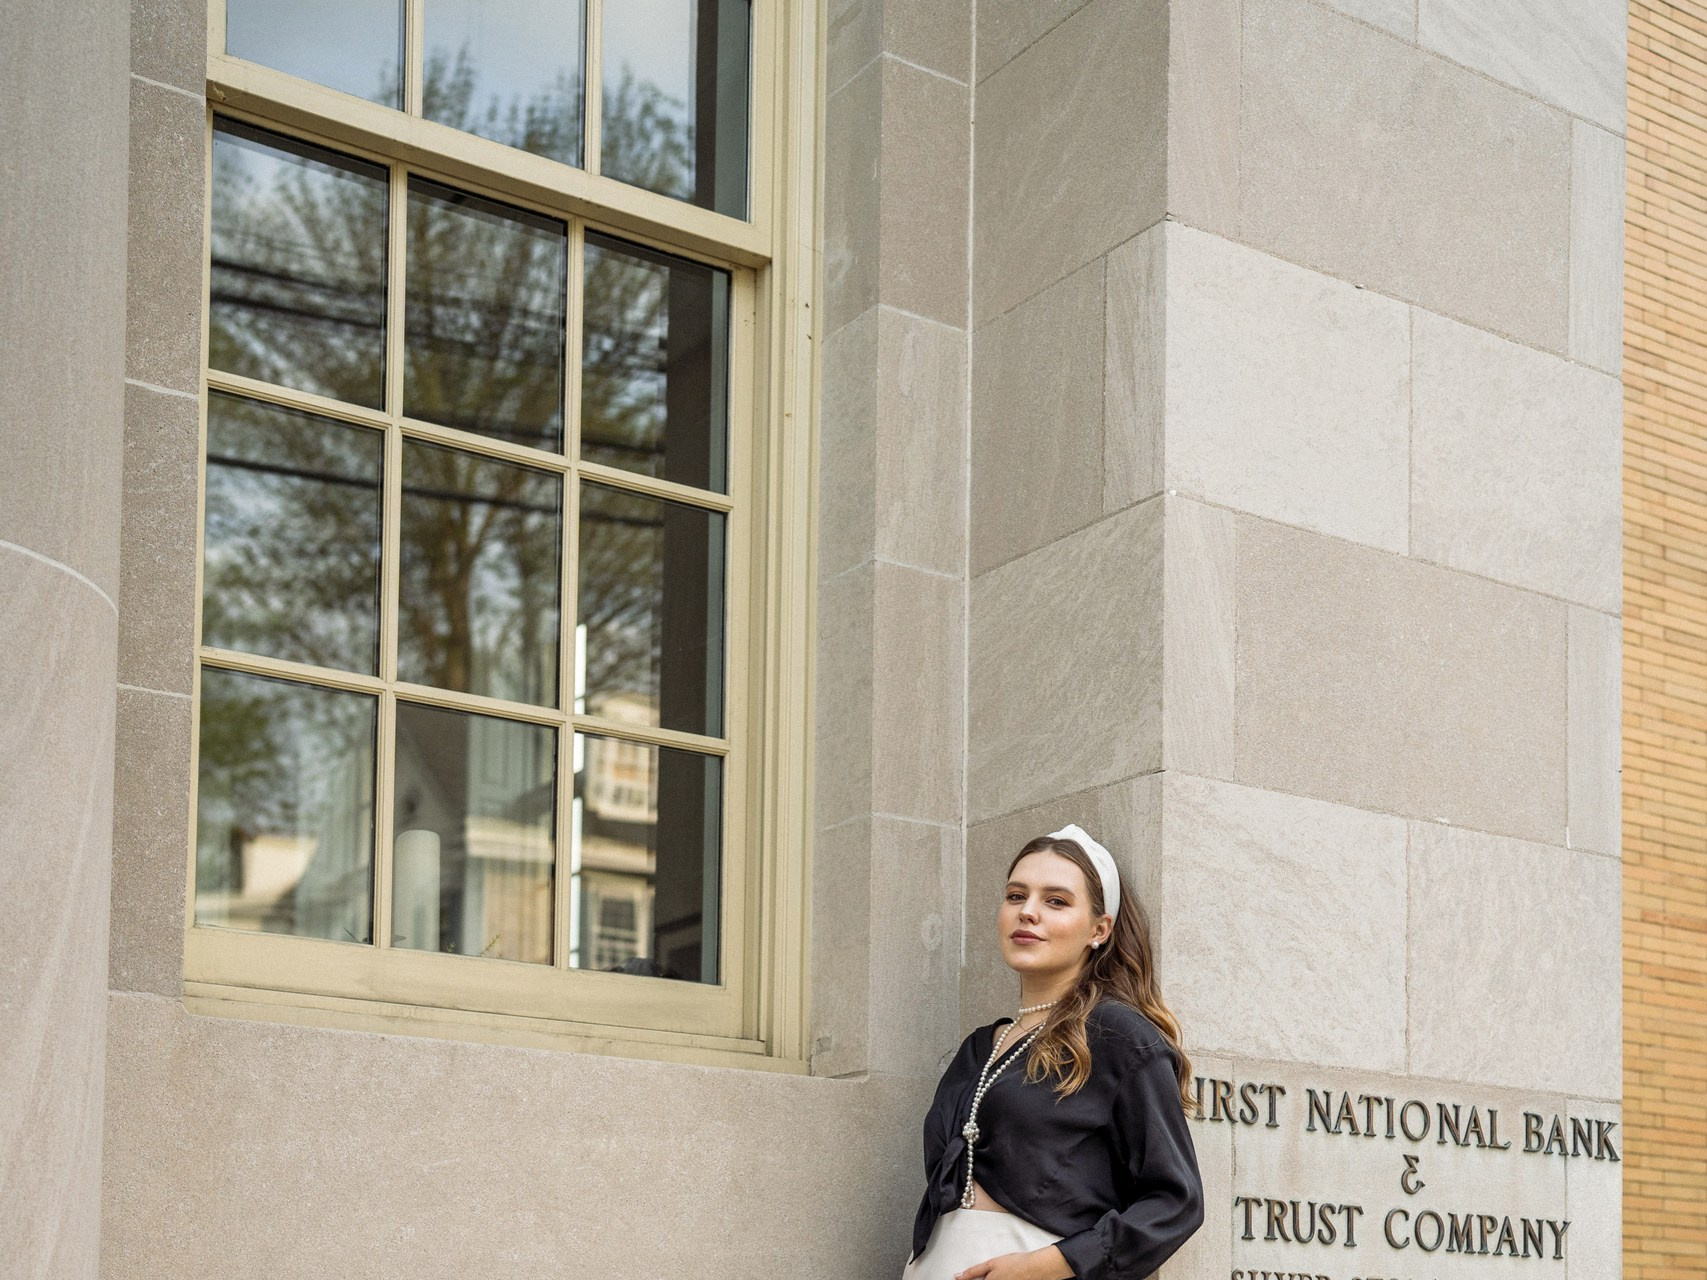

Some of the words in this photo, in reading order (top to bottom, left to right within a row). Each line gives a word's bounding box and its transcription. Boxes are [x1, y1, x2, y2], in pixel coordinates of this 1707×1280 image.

[1194, 1076, 1287, 1128] IRST
[1306, 1089, 1512, 1150] NATIONAL
[1523, 1111, 1621, 1162] BANK
[1400, 1154, 1426, 1195] &
[1234, 1196, 1364, 1248] TRUST
[1384, 1208, 1571, 1260] COMPANY
